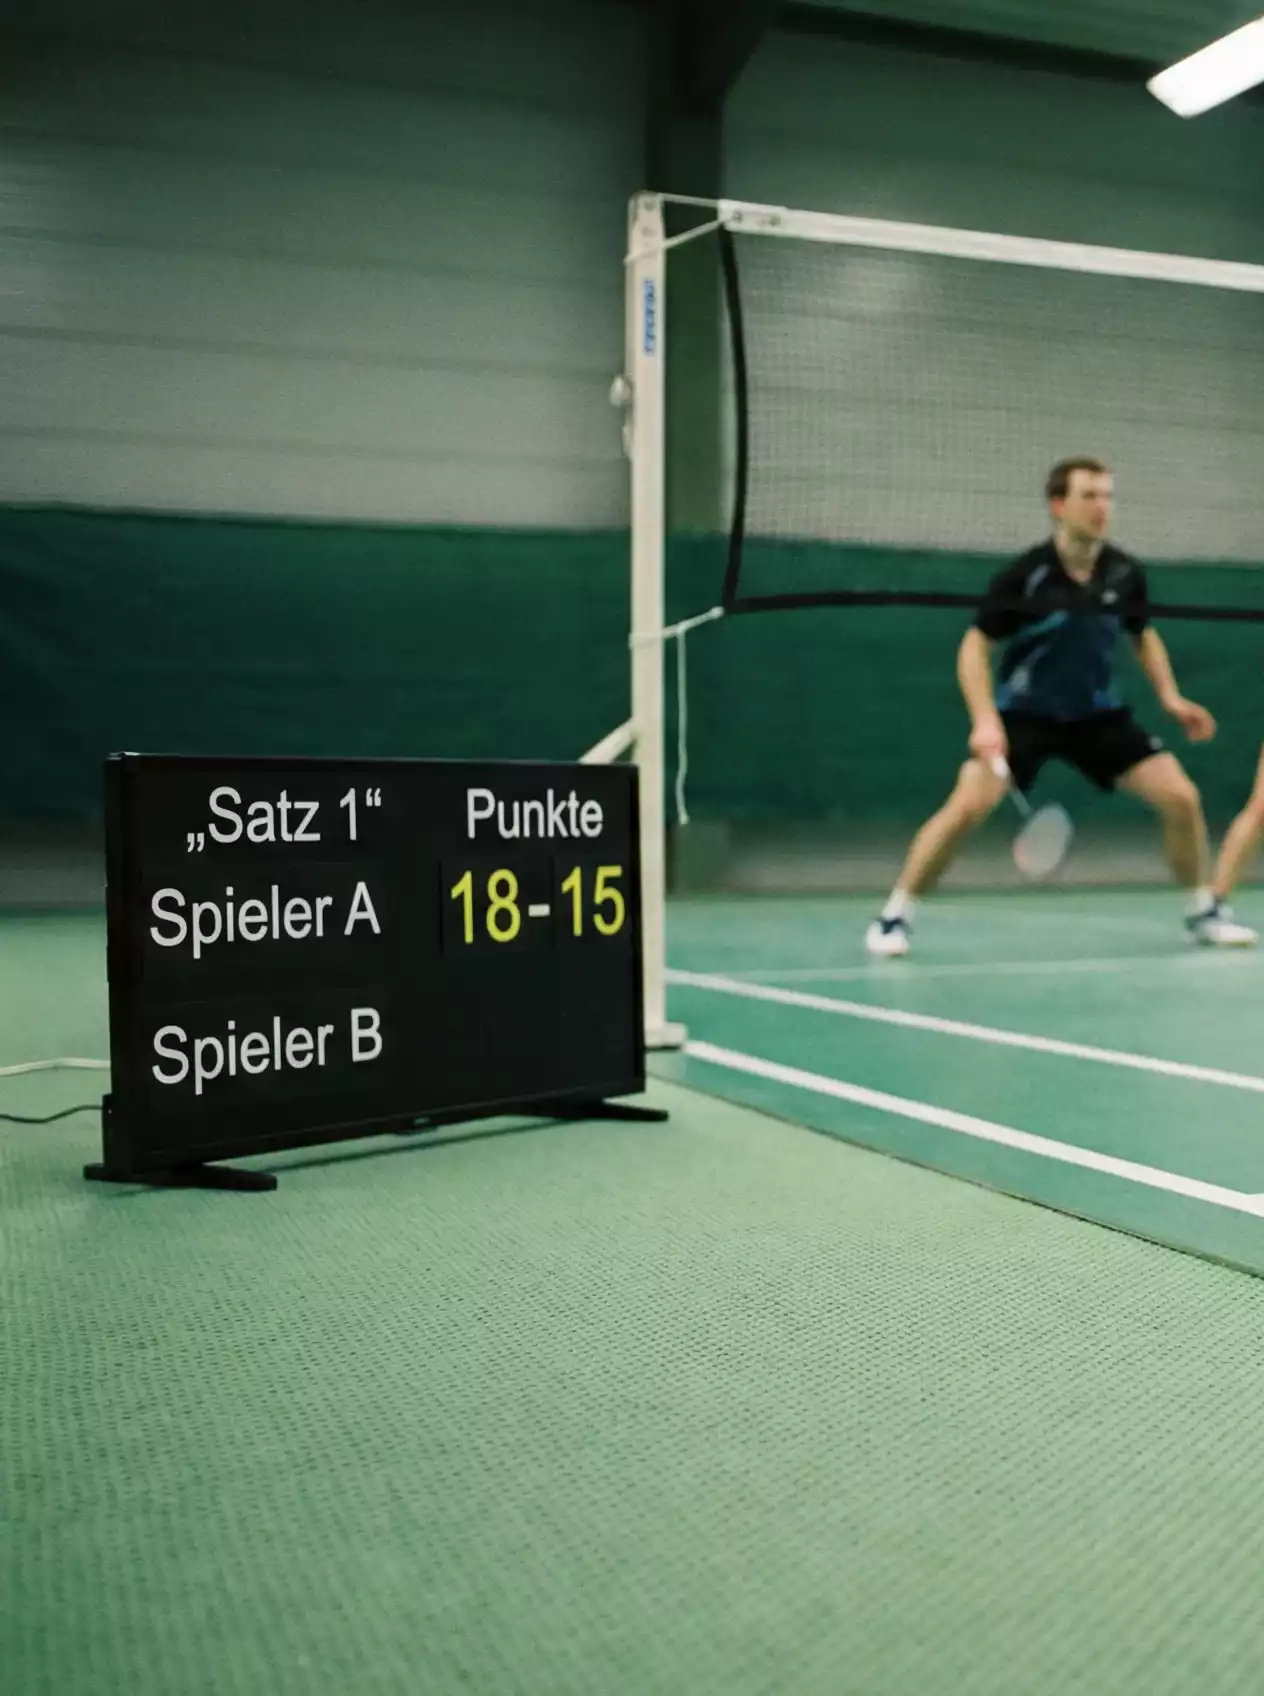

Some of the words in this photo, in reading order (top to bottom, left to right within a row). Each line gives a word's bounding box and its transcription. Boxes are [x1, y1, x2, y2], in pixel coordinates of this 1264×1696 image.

[186, 787, 321, 852] „Satz
[339, 788, 382, 841] 1“
[467, 788, 604, 838] Punkte
[150, 885, 333, 959] Spieler
[344, 881, 381, 935] A
[451, 865, 625, 943] 18-15
[152, 1016, 334, 1095] Spieler
[351, 1007, 383, 1062] B
